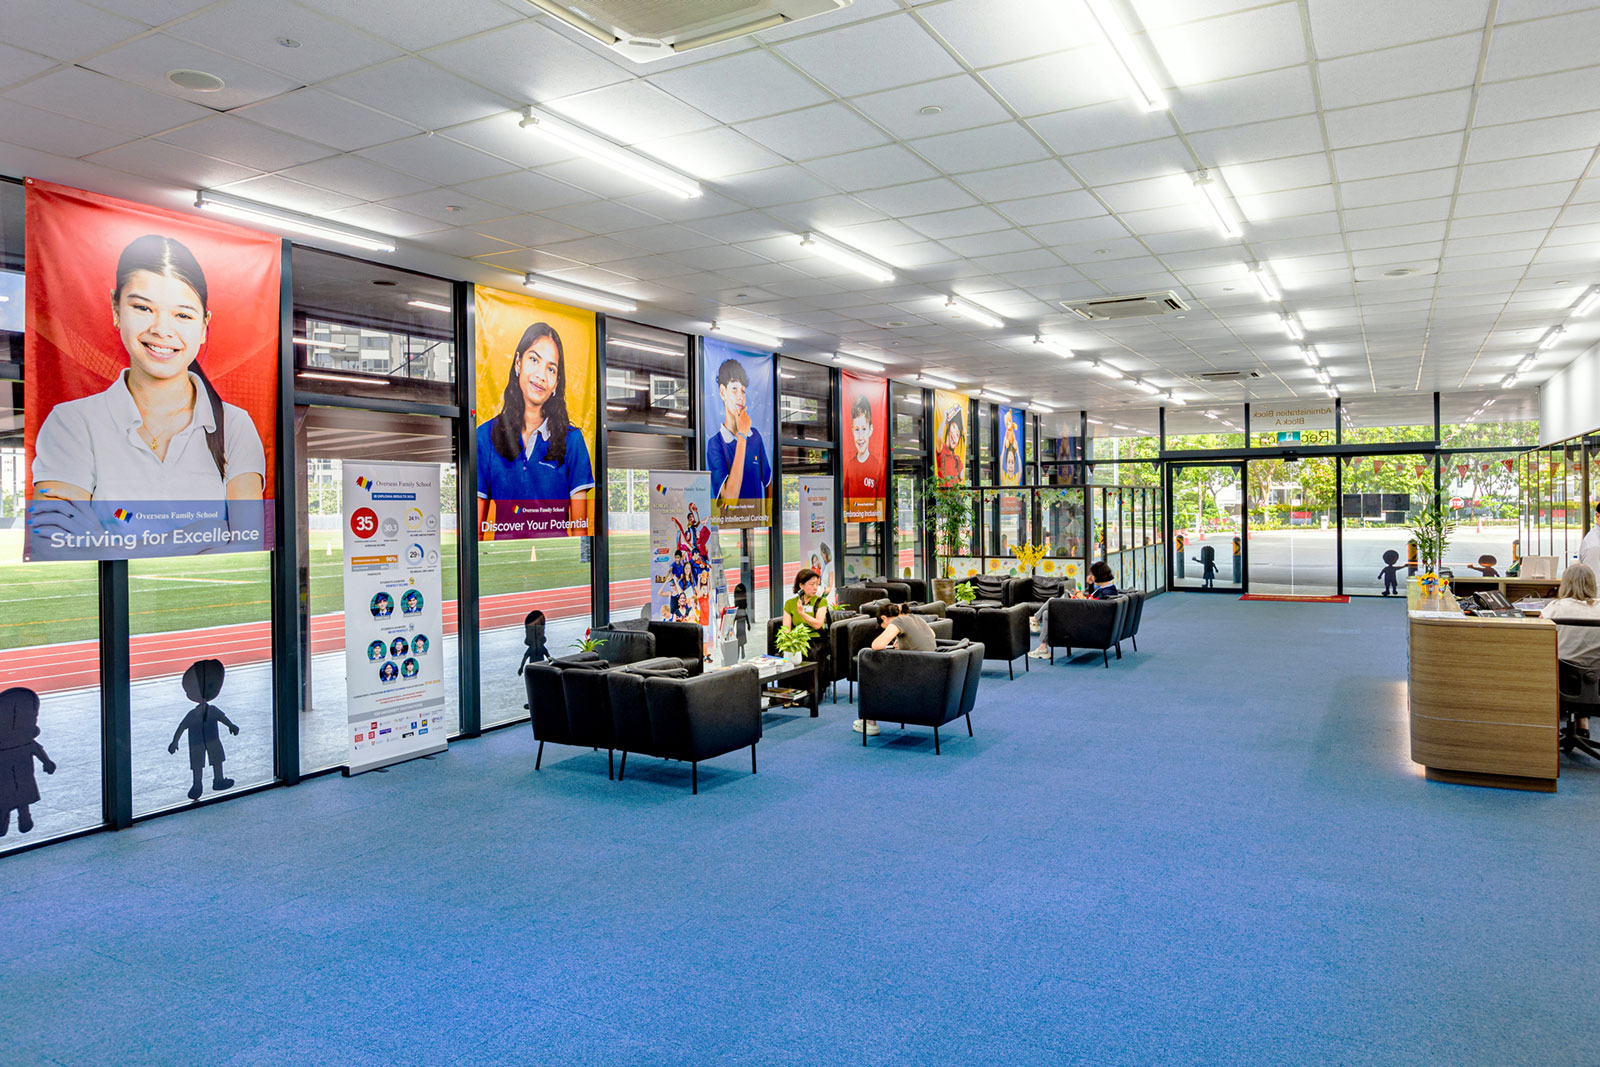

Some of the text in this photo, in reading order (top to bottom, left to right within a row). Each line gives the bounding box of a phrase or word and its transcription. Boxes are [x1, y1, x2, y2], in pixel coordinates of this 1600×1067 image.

[399, 481, 415, 489] Family
[863, 477, 875, 488] OFS
[135, 509, 219, 521] Overseas Family School
[725, 514, 750, 523] Intellectual
[751, 513, 769, 523] Curiosity
[356, 515, 374, 531] 35
[481, 517, 589, 533] Discover Your Potential
[50, 527, 260, 550] Striving for Excellence
